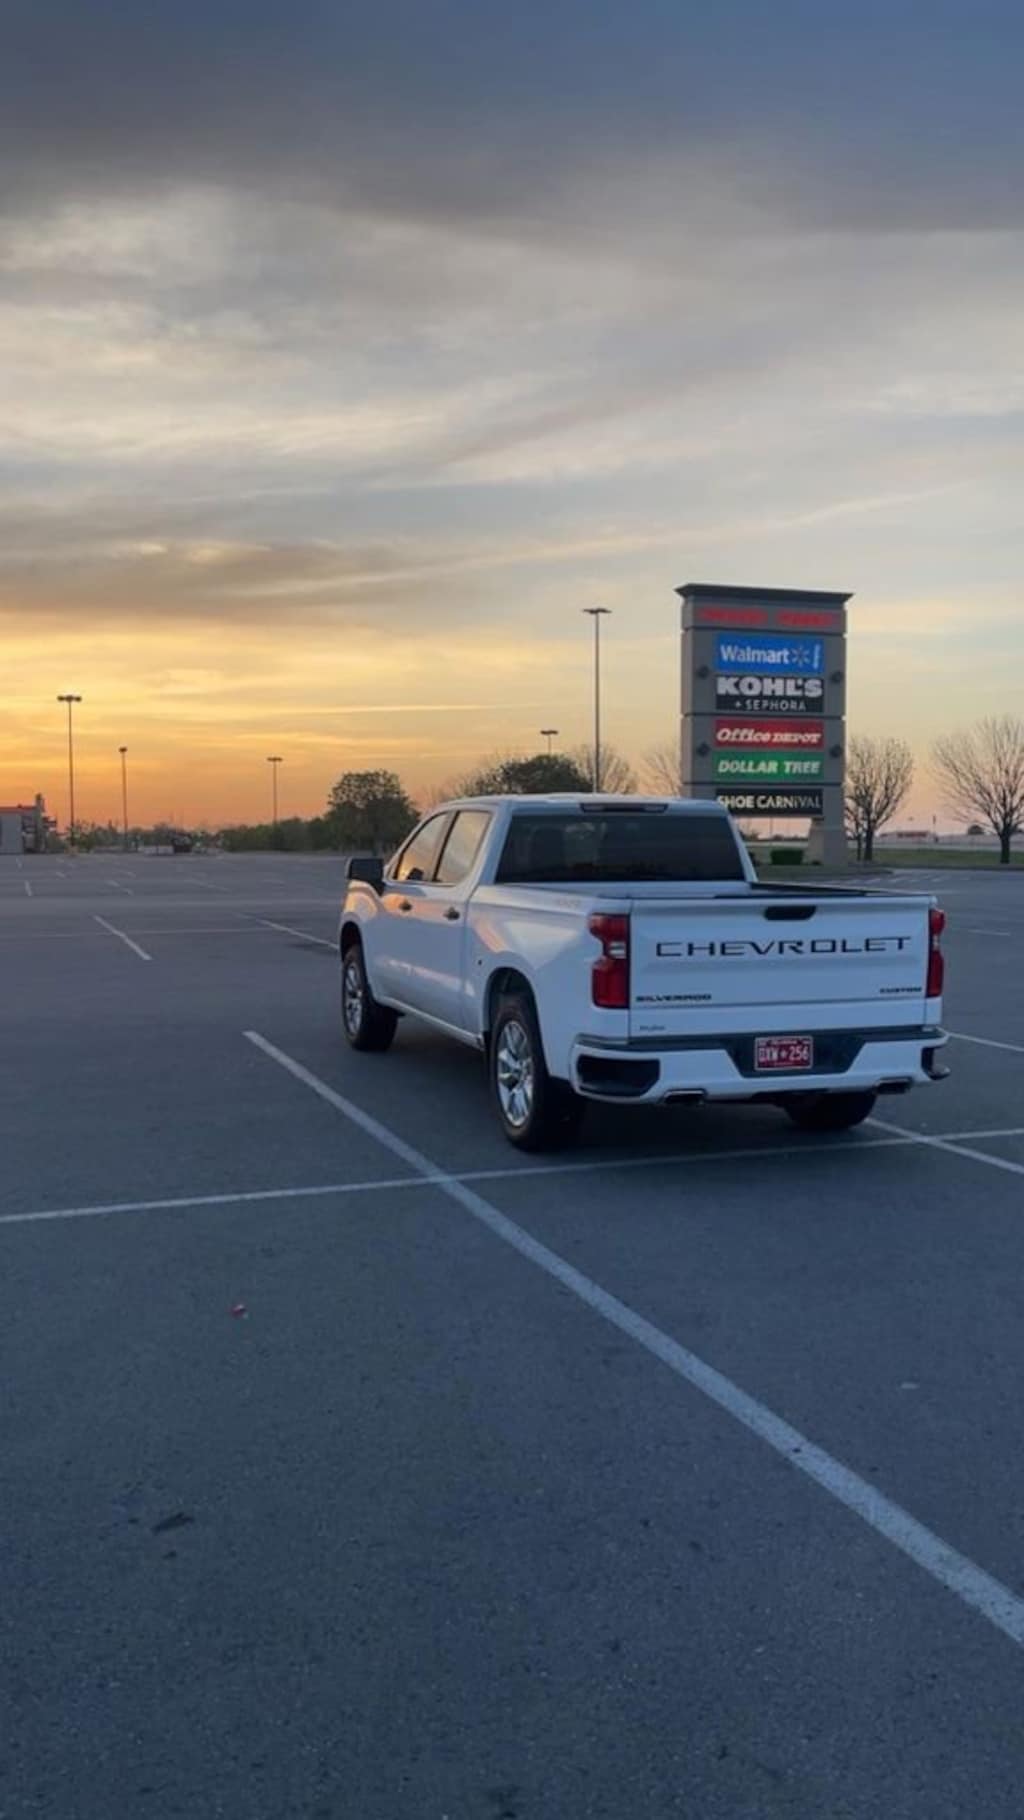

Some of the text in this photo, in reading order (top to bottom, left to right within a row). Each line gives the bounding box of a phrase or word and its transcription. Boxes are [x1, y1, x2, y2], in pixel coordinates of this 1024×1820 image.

[720, 645, 790, 665] Walmart
[717, 676, 822, 697] KOHL'S
[745, 699, 806, 711] SEPHORA
[716, 727, 821, 744] Office DEPOT
[718, 760, 820, 774] DOLLAR TREE
[717, 795, 821, 809] SHOE CARNIVAL
[656, 936, 911, 957] CHEVROLET
